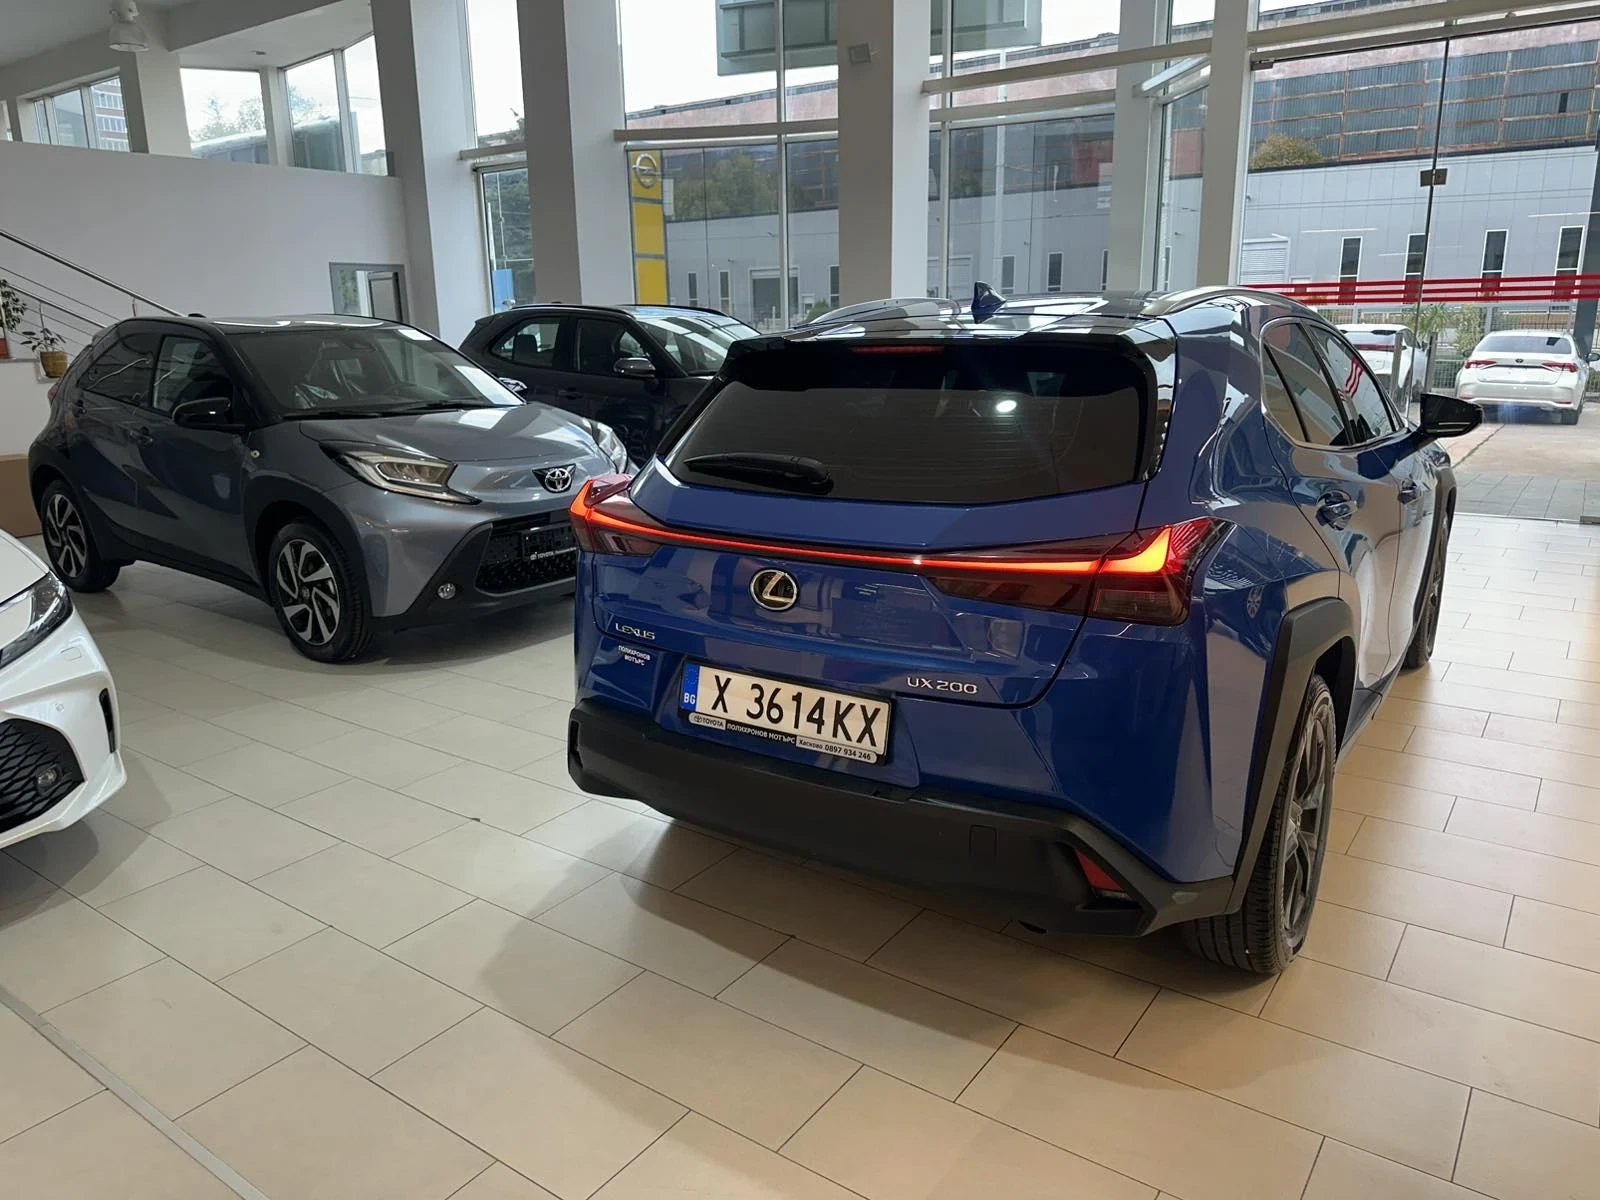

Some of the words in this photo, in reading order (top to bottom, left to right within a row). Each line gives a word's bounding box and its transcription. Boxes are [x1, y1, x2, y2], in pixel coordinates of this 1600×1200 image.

[615, 622, 656, 640] LEXUS
[907, 677, 934, 690] UX
[936, 680, 978, 694] 200
[683, 692, 696, 705] BG
[702, 717, 725, 728] TOYOTA
[726, 723, 768, 738] ПОЛИХРОНОВ
[768, 732, 796, 745] МОТЪРС
[798, 739, 823, 750] Хасково
[824, 744, 842, 754] 0897
[843, 748, 857, 757] 934
[858, 751, 871, 760] 246
